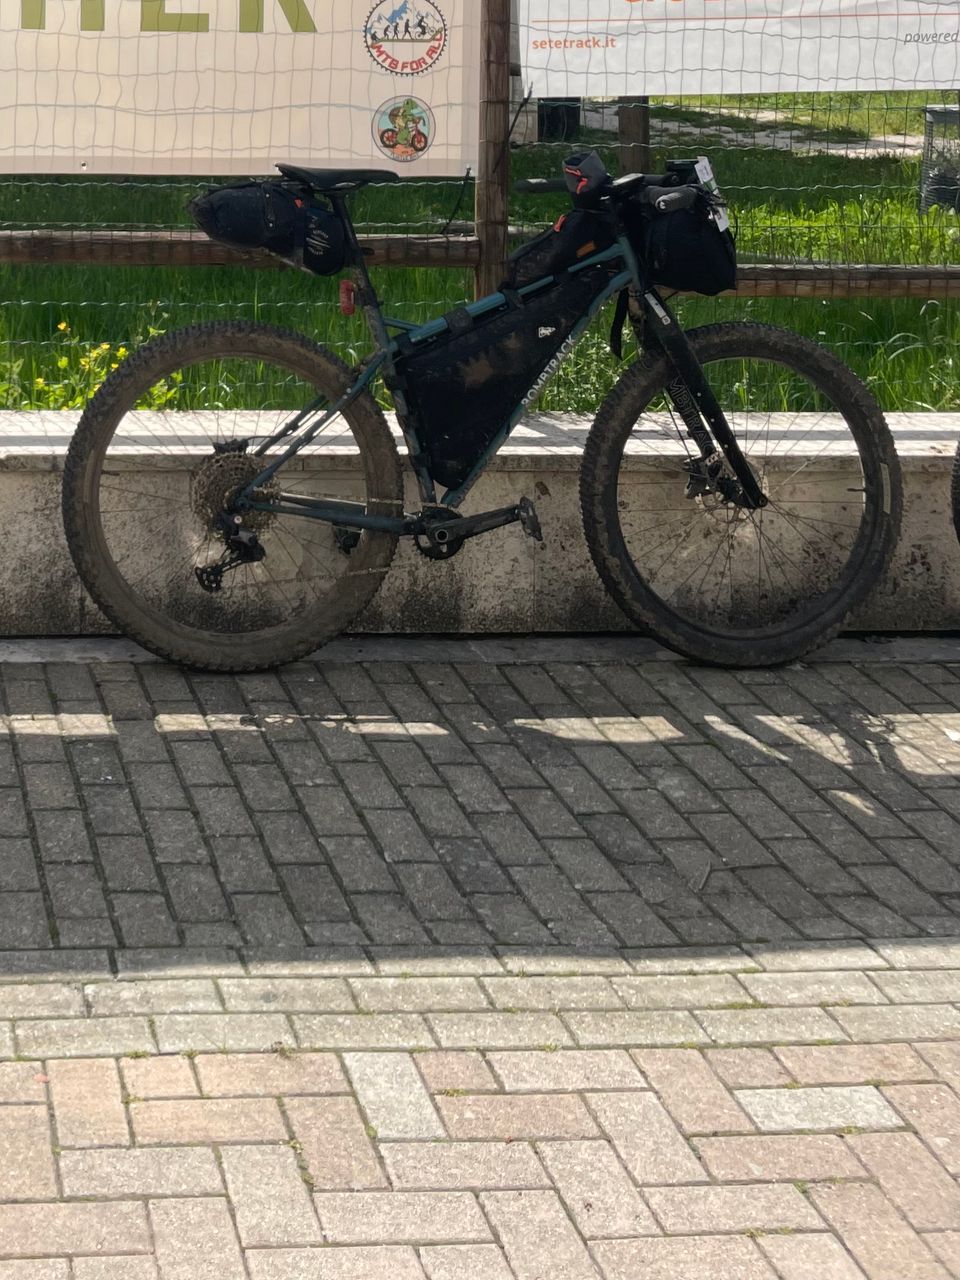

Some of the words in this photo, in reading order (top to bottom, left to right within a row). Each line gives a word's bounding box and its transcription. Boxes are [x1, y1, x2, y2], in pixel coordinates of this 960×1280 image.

[531, 36, 617, 50] setetrack.it
[903, 28, 960, 46] powered
[371, 43, 400, 70] MTB
[400, 57, 428, 72] FOR
[426, 33, 444, 60] ALL
